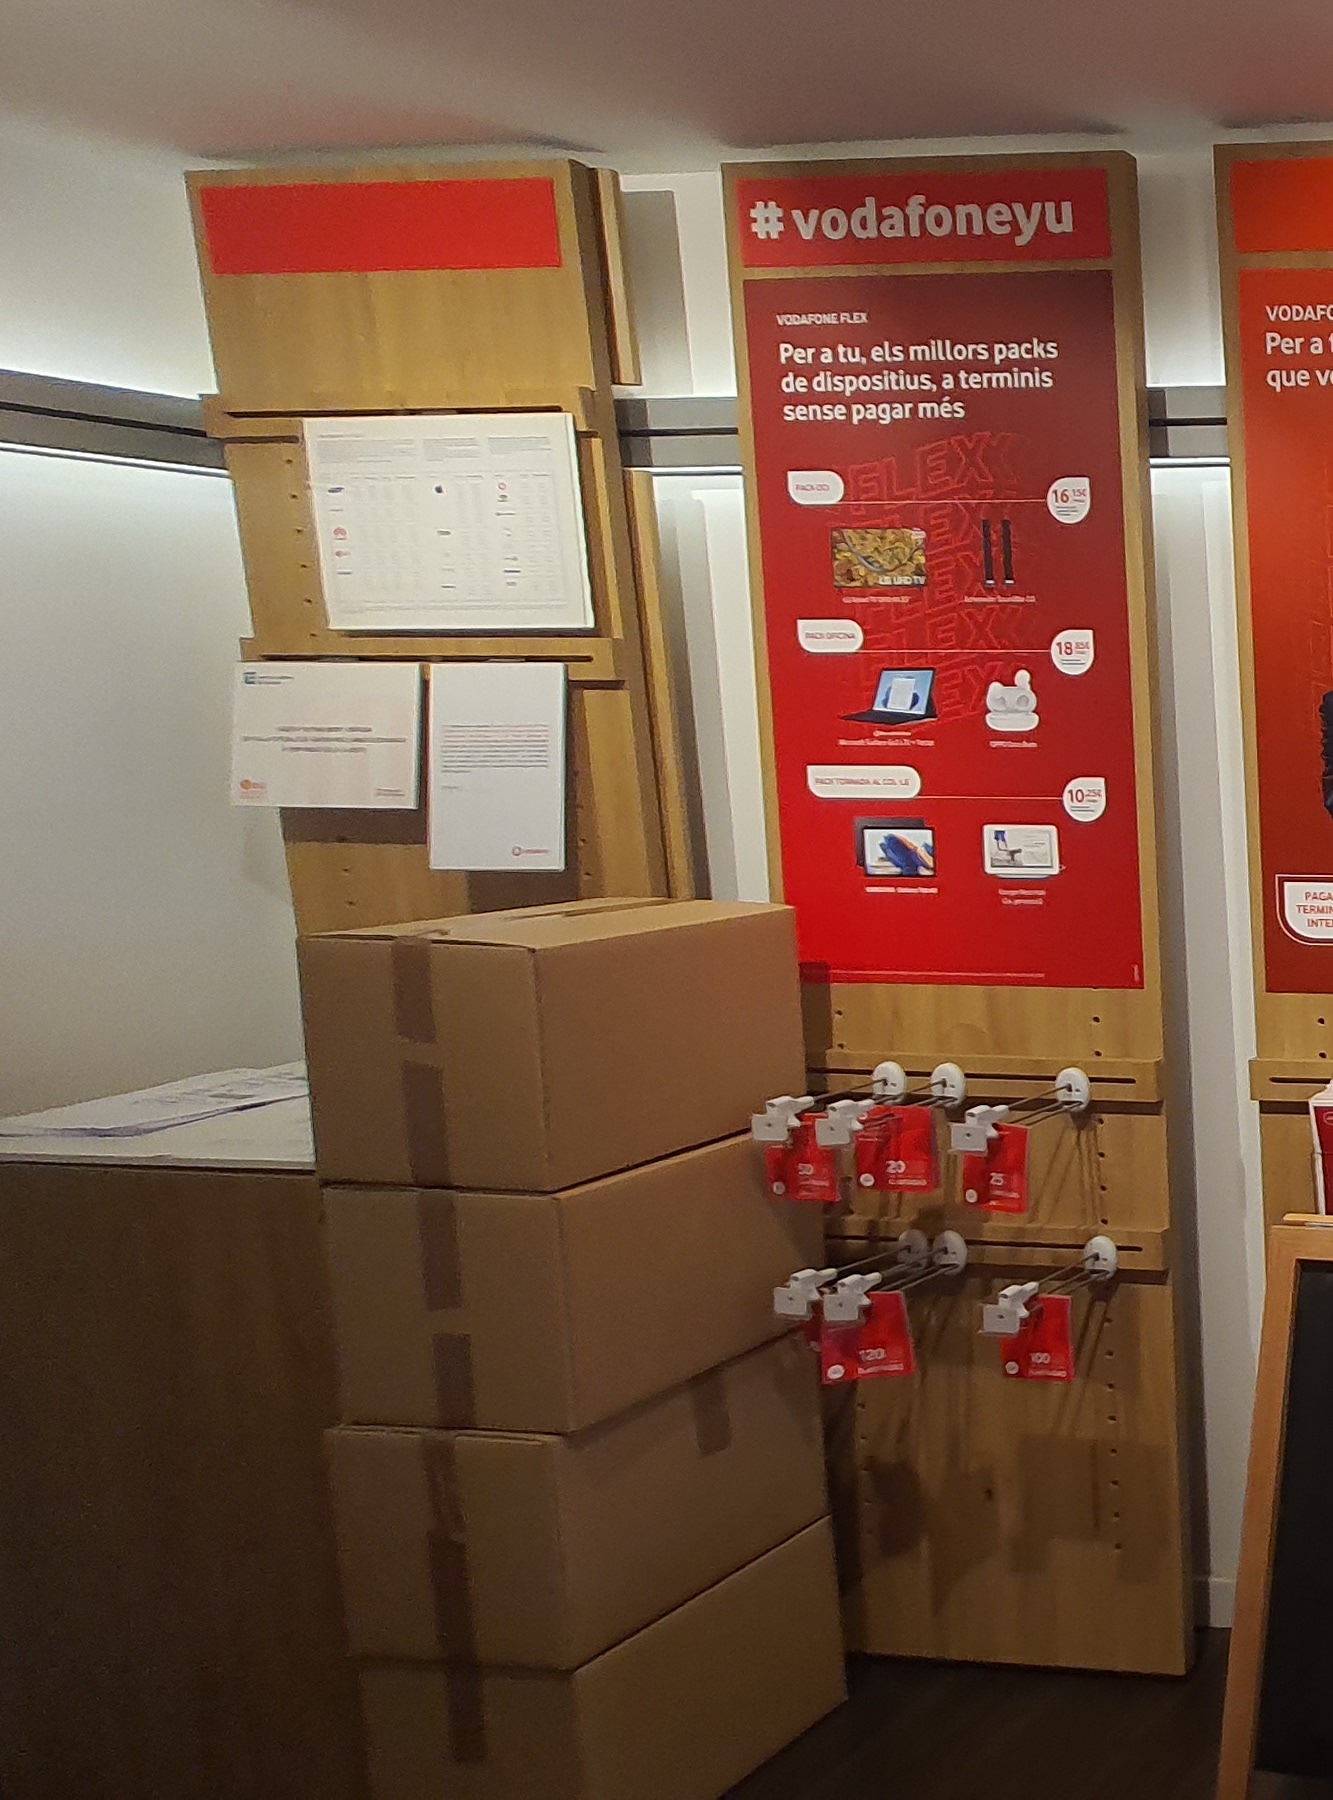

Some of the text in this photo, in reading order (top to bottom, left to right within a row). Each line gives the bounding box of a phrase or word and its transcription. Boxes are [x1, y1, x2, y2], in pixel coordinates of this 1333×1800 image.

[776, 311, 869, 326] VODAFONE FLEX
[779, 337, 1059, 368] Per a tu, els millors packs
[1265, 332, 1306, 356] Per
[1308, 336, 1324, 355] a
[781, 366, 1054, 398] de dispositius, a terminis
[1265, 369, 1311, 393] que
[783, 396, 966, 426] sense pagar més
[1052, 489, 1070, 504] 16
[1056, 641, 1074, 656] 18
[1067, 788, 1084, 803] 10
[885, 1159, 907, 1174] 20
